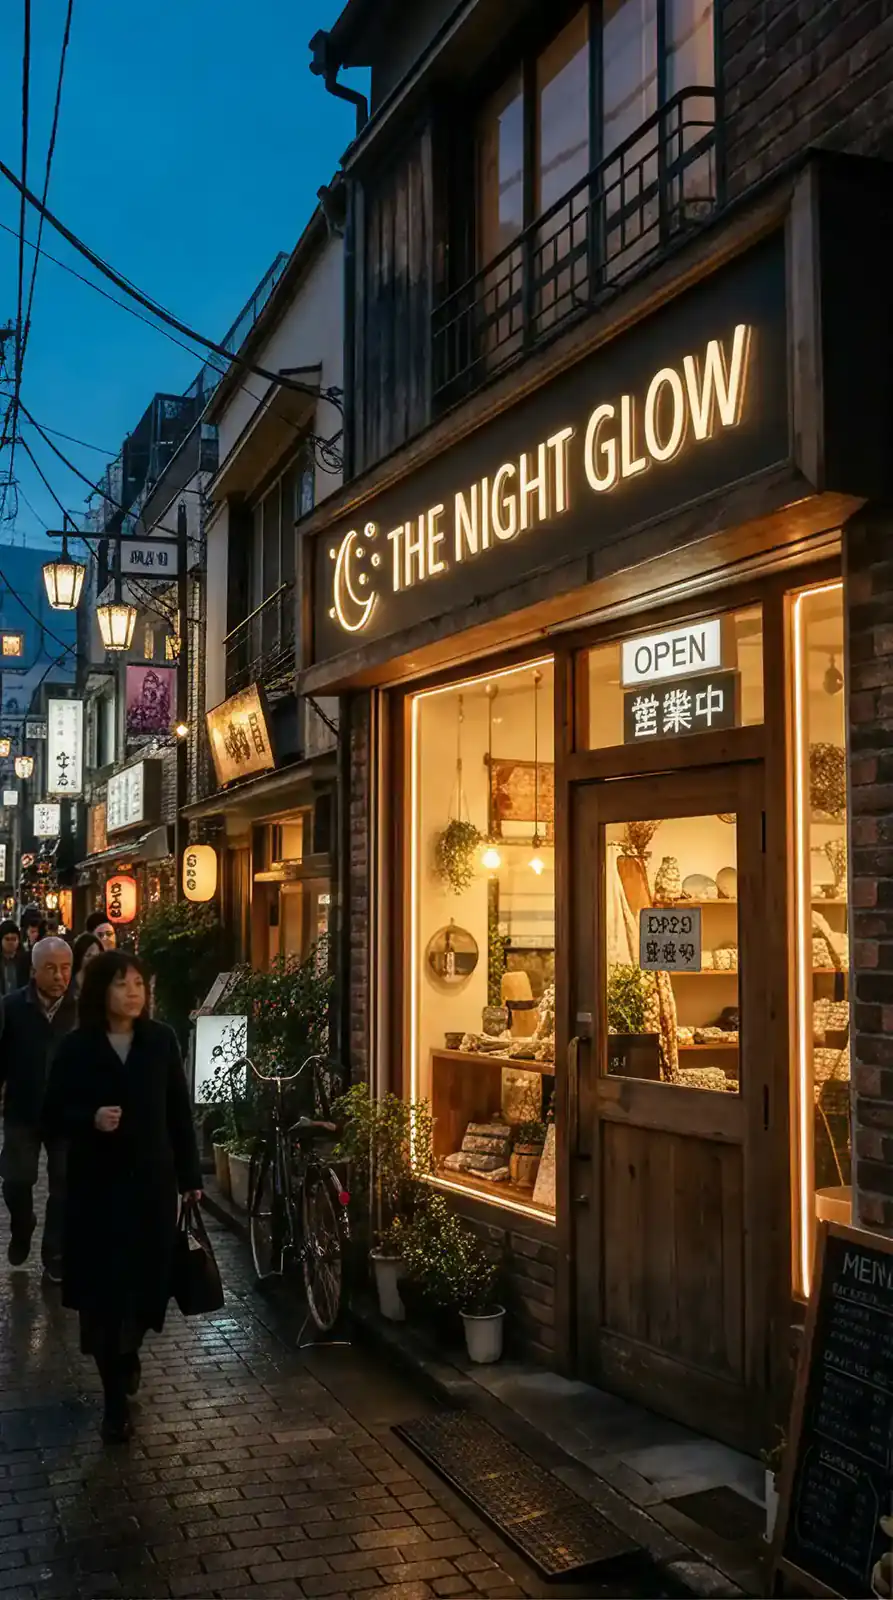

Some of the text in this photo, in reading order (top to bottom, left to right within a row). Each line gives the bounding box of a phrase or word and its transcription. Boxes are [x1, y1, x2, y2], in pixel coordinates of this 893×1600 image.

[387, 324, 750, 592] THE NIGHT GLOW
[634, 631, 706, 674] OPEN
[631, 684, 724, 737] 営業中
